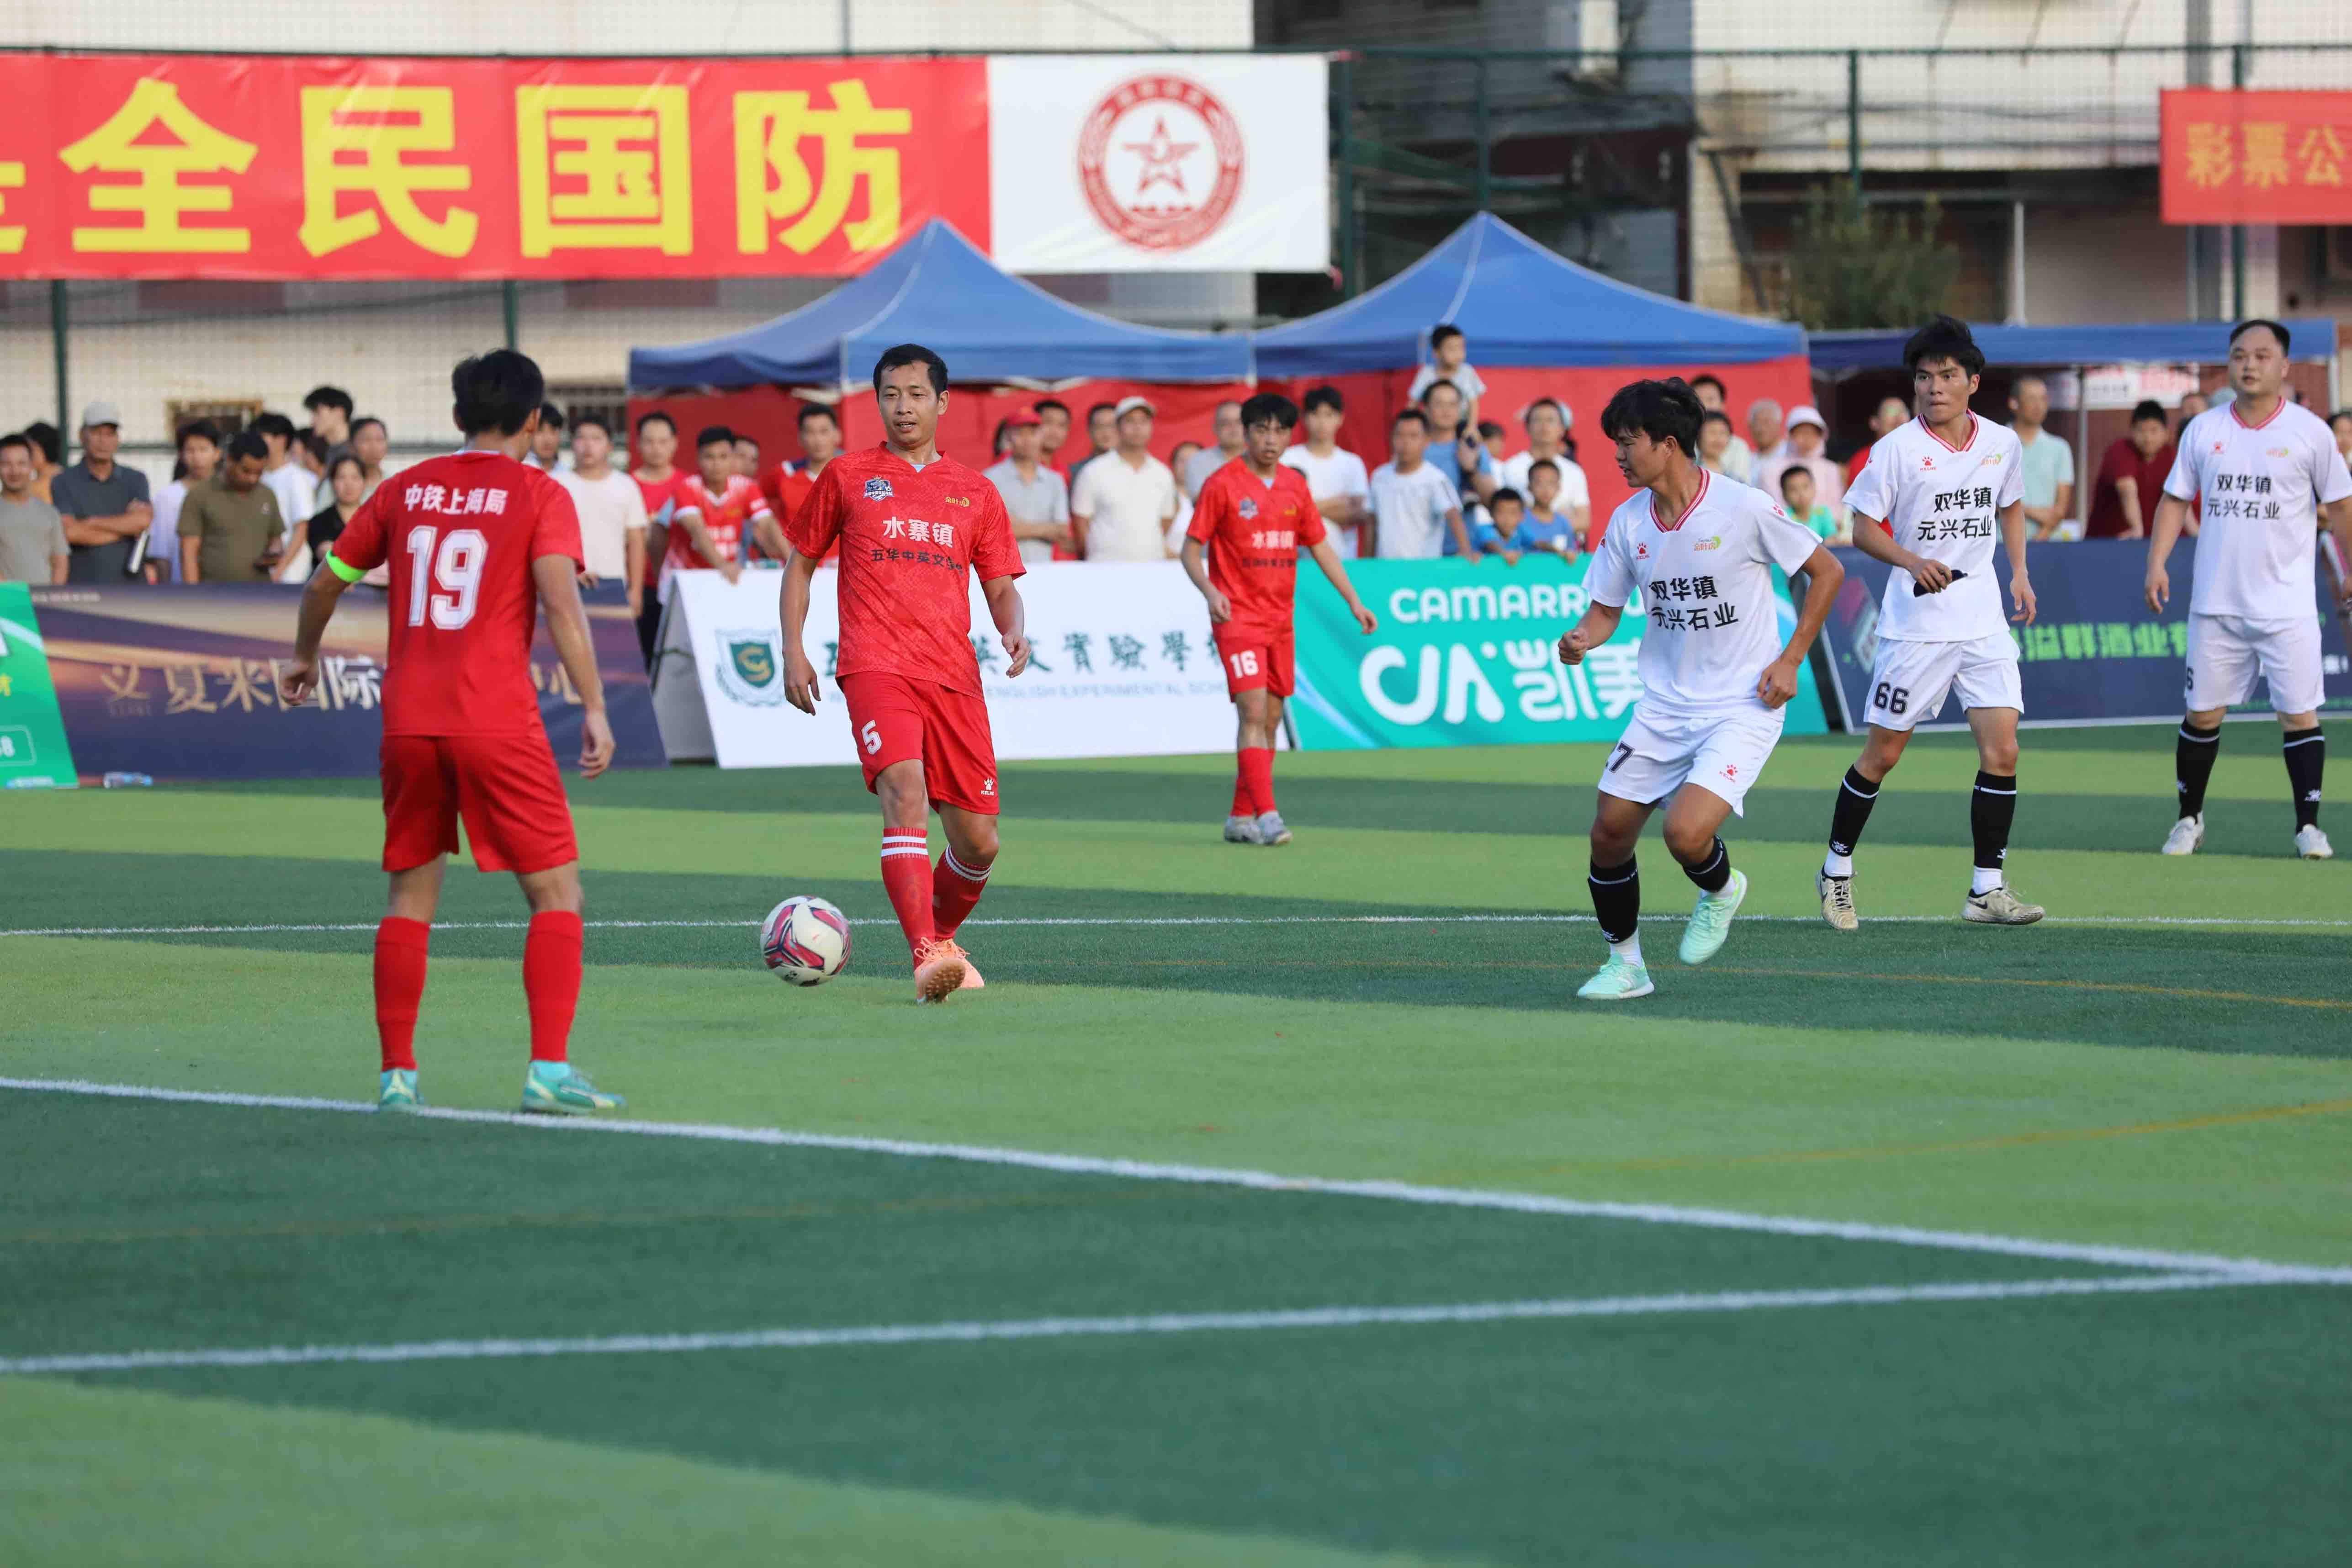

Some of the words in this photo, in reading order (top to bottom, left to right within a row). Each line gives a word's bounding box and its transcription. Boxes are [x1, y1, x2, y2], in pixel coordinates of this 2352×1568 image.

[2185, 122, 2346, 189] 彩票公
[404, 483, 508, 515] 中铁上海局
[2217, 473, 2271, 494] 双华镇
[1934, 487, 1992, 513] 双华镇
[2207, 497, 2280, 520] 元兴石业
[882, 516, 954, 548] 水寨镇
[1918, 515, 1992, 540] 元兴石业
[407, 525, 489, 630] 19
[1648, 575, 1718, 601] 双华镇
[1650, 601, 1739, 631] 元兴石业
[2009, 621, 2188, 663] 溢群酒业
[1229, 650, 1260, 680] 16
[1874, 682, 1910, 715] 66
[862, 720, 882, 755] 5
